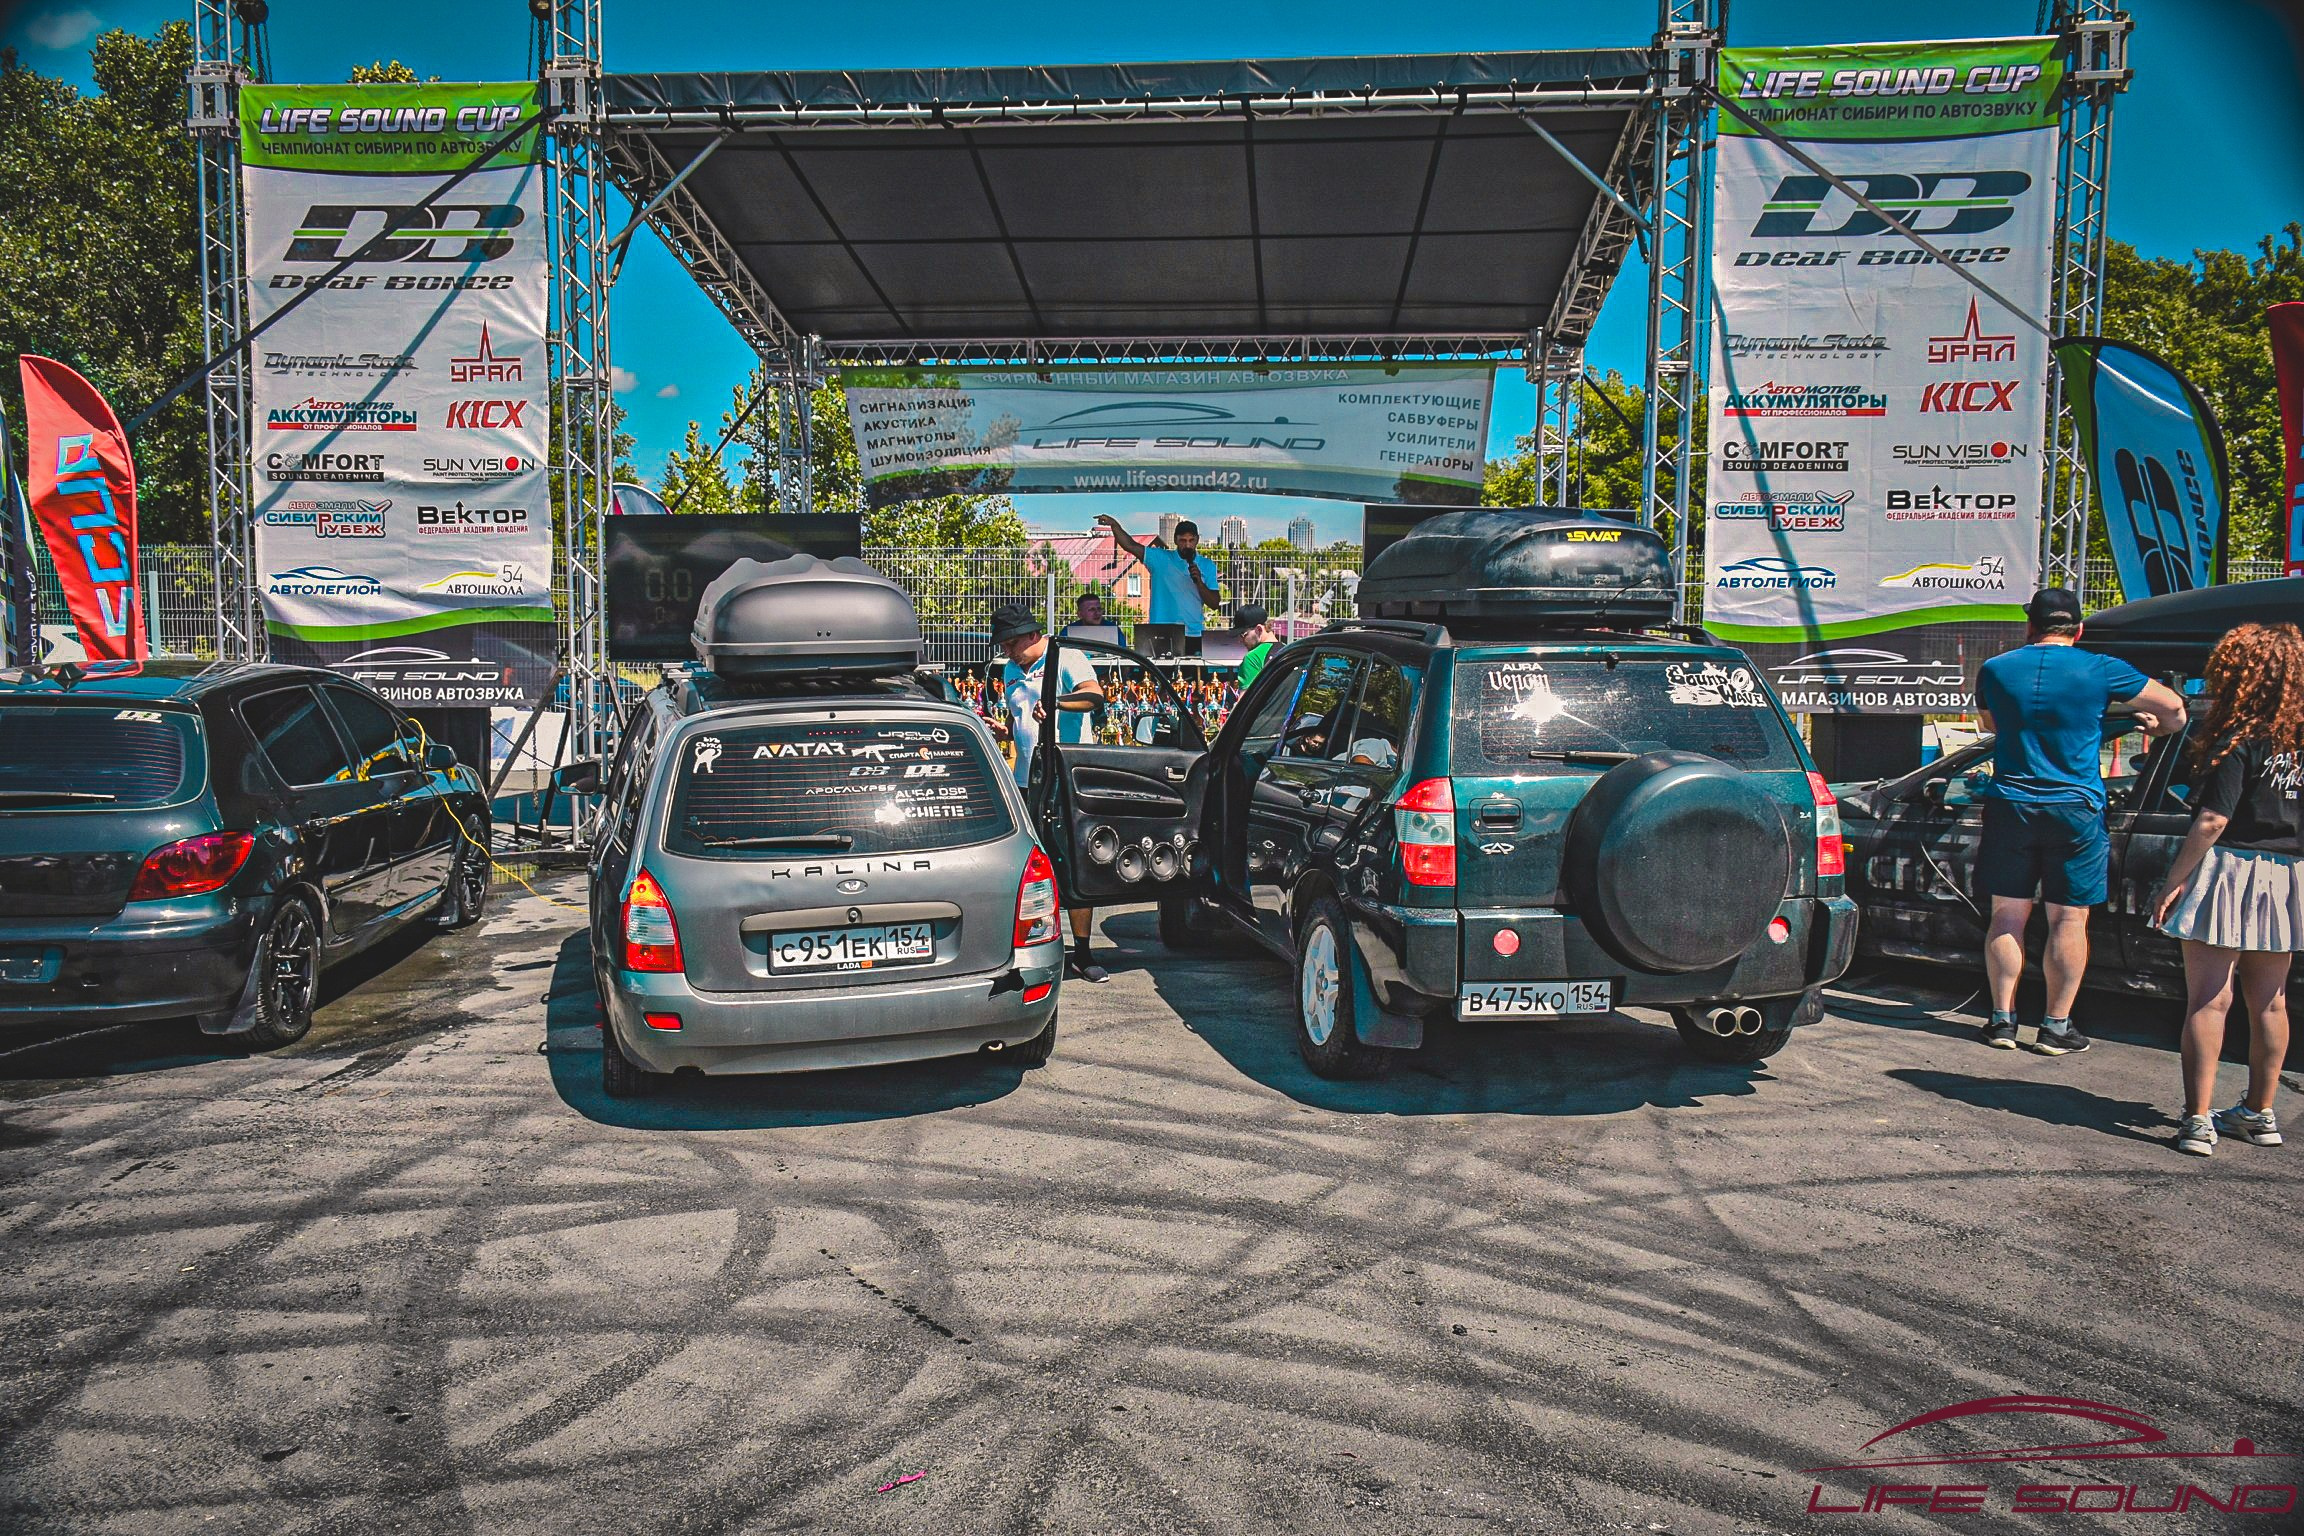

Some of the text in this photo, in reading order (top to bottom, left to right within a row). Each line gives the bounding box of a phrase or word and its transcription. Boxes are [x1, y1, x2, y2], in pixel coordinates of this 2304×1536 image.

[1739, 64, 2041, 99] LIFE SOUND CUP
[1842, 104, 1908, 120] СИБИРИ
[1913, 104, 1934, 119] ПО
[1940, 101, 2037, 119] АВТОЗВУКУ
[260, 104, 521, 134] LIFE SOUND CUP
[262, 141, 350, 155] ЧЕМПИОНАТ
[355, 141, 411, 155] СИБИРИ
[415, 141, 436, 154] ПО
[1751, 171, 2031, 237] DB
[283, 205, 525, 262] DB
[1723, 334, 1890, 357] Dynamic State
[1928, 343, 2015, 363] УРАЛ
[264, 352, 419, 374] Dynamic State
[451, 365, 522, 382] УРАЛ
[982, 370, 1349, 386] ФИРМЕННЫЙ МАГАЗИН АВТОЗВУКА
[1338, 393, 1480, 411] КОМПЛЕКТУЮЩИЕ
[1724, 394, 1887, 408] АККУМУЛЯТОРЫ
[1920, 381, 2019, 412] KICX
[446, 400, 527, 428] KICX
[859, 398, 976, 414] СИГНАЛИЗАЦИЯ
[267, 409, 417, 423] АККУМУЛЯТОРЫ
[1388, 411, 1478, 431] САБВУФЕРЫ
[863, 417, 936, 433] АКУСТИКА
[867, 431, 955, 450] МАГНИТОЛЫ
[1032, 436, 1325, 450] LIFE SOUND
[1387, 431, 1476, 451] УСИЛИТЕЛИ
[870, 445, 991, 468] ШУМОИЗОЛЯЦИЯ
[1893, 444, 1940, 458] SUN
[423, 458, 463, 471] SUN
[1380, 450, 1474, 472] ГЕНЕРАТОРЫ
[1727, 462, 1843, 470] SOUND DEADENING
[1074, 469, 1267, 489] www.lifesound42.ru
[1741, 493, 1813, 501] АВТОЭМАЛИ
[288, 501, 356, 510] АВТОЭМАЛИ
[1887, 511, 2016, 520] ФЕДЕРАЛЬНАЯ АКАДЕМИЯ ВОЖДЕНИЯ
[419, 526, 460, 535] ФЕДЕРАЛЬНАЯ
[497, 525, 529, 533] ВОЖДЕНИЯ
[1566, 531, 1621, 542] SWAT
[502, 565, 523, 583] 54
[1980, 557, 2004, 576] 54
[269, 585, 381, 595] АВТОЛЕГИОН
[446, 584, 524, 595] АВТОШКОЛА
[1717, 577, 1836, 588] АВТОЛЕГИОН
[1912, 577, 2004, 589] АВТОШКОЛА
[1502, 663, 1543, 671] AURA
[352, 671, 499, 681] IFE SOUND
[1777, 675, 1965, 685] LIFE SOUND
[436, 686, 525, 700] АВТОЗВУКА
[1782, 691, 1976, 707] МАГАЗИНОВ АВТОЗВУ
[753, 742, 846, 759] AVATAR
[805, 784, 897, 795] APOCALYPSE
[938, 787, 967, 796] DSP
[903, 804, 965, 818] CHETE
[771, 860, 930, 880] KALINA
[781, 926, 928, 963] С951ЕК 154
[897, 946, 916, 955] RUS
[837, 962, 860, 970] LADA
[1470, 984, 1605, 1012] В475КО 154
